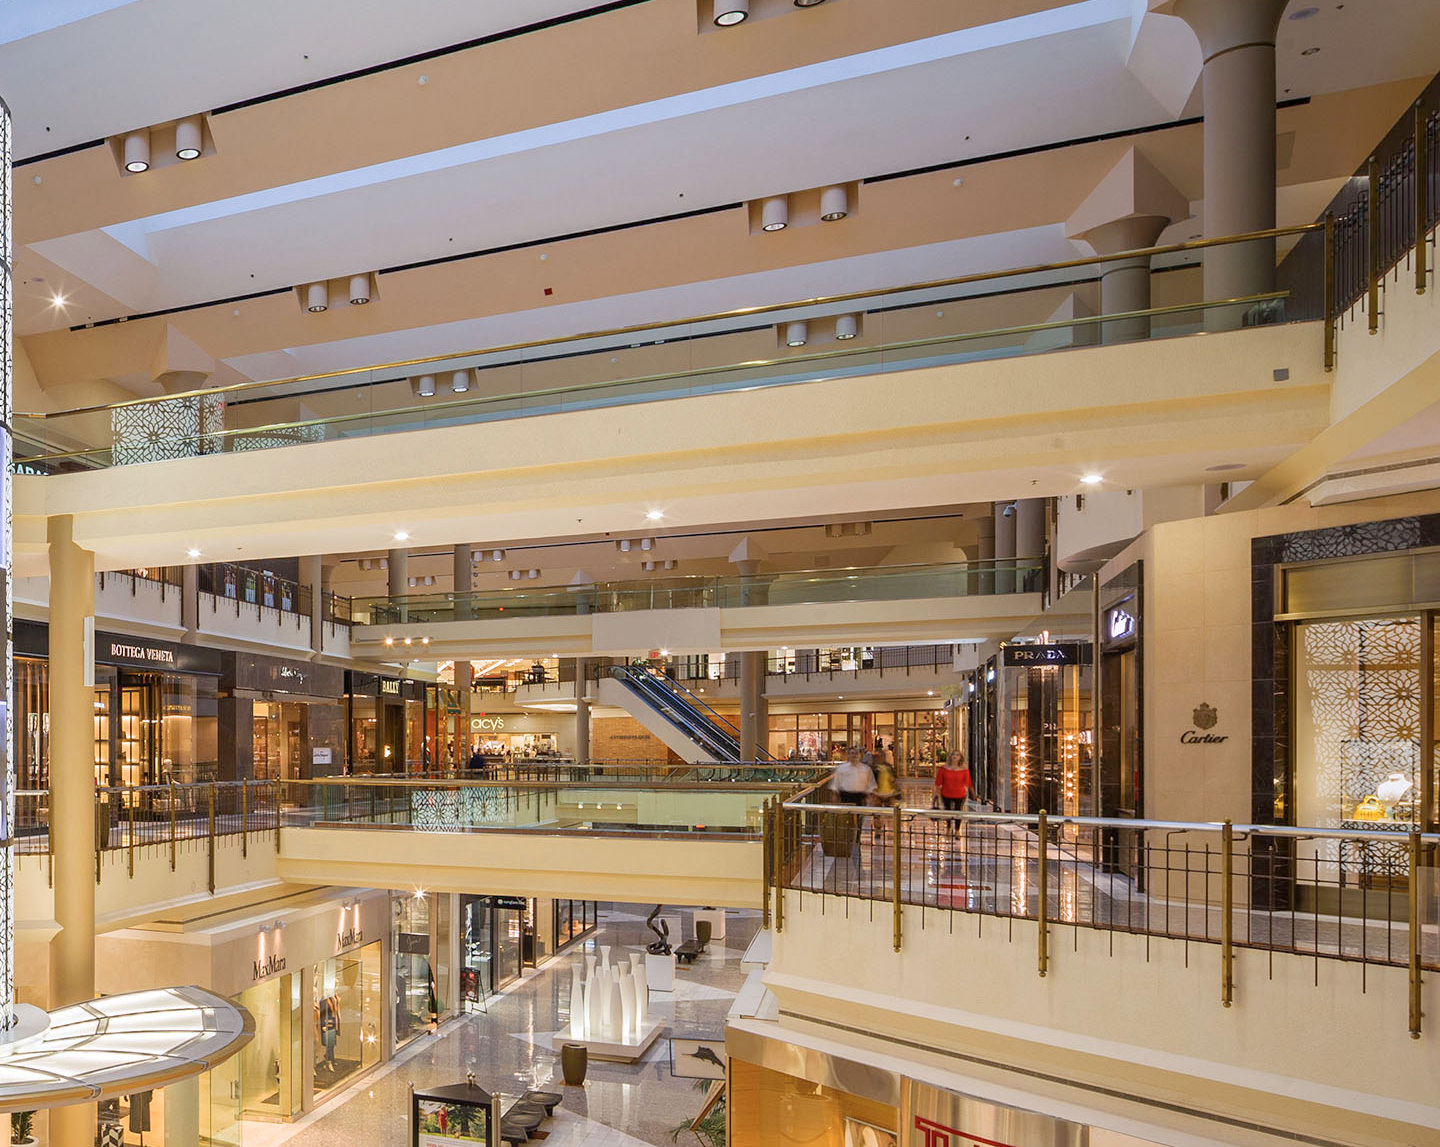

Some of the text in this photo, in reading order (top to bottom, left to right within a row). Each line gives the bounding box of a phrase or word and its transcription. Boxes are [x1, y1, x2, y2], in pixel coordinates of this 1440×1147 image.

[111, 643, 173, 662] BOTTEGA VENETA
[1014, 649, 1065, 660] PRADA
[382, 680, 400, 695] BALLY
[471, 716, 504, 731] acy's
[1180, 730, 1229, 744] Cartier
[337, 928, 363, 951] MaxMara
[252, 954, 287, 981] MaxMara
